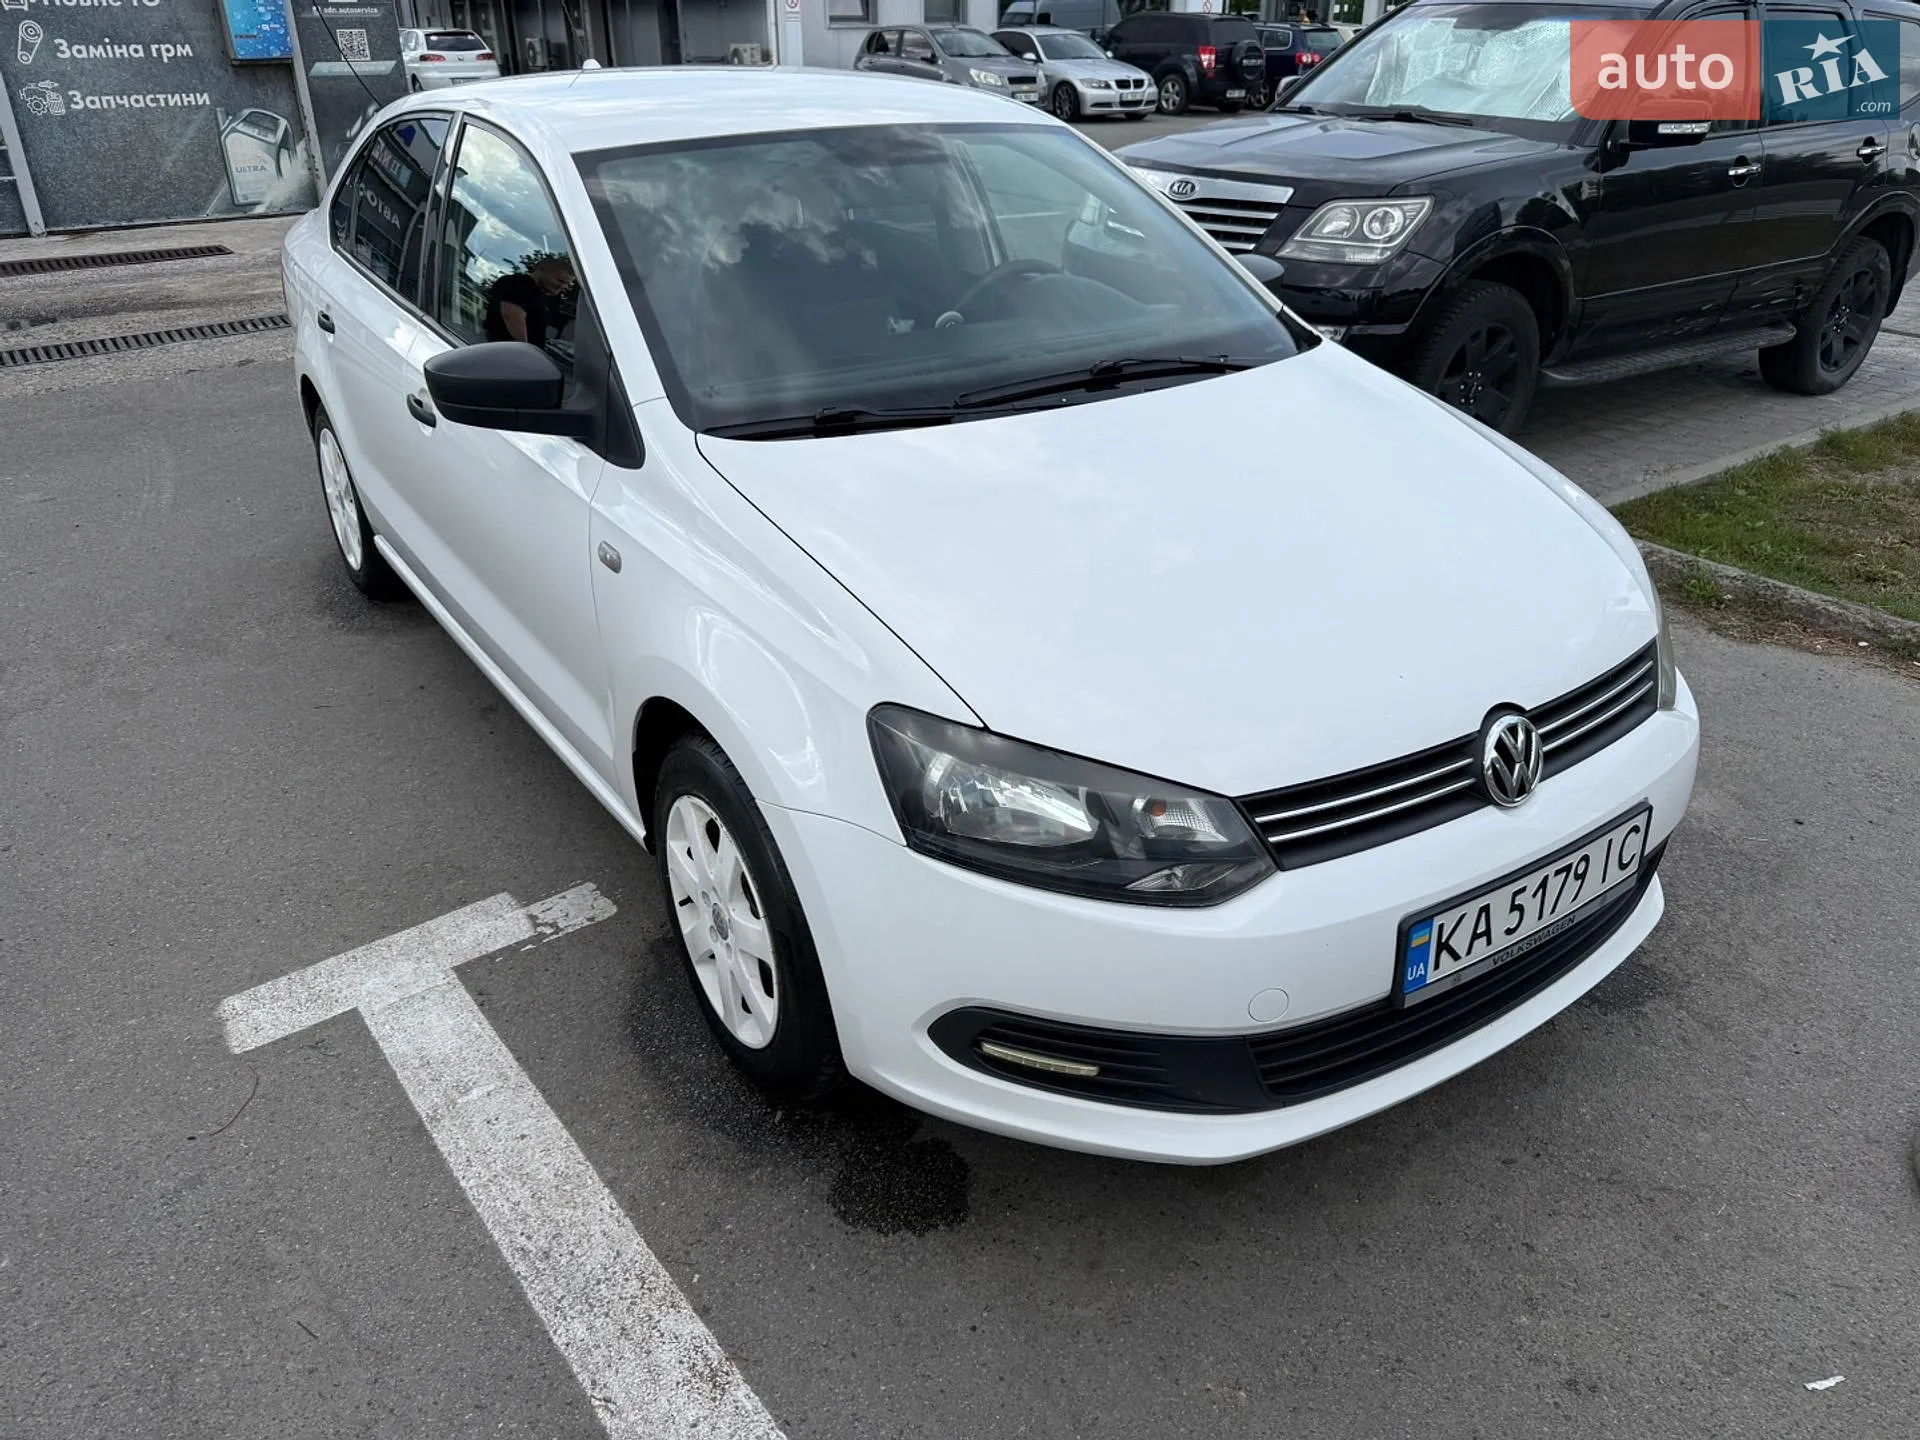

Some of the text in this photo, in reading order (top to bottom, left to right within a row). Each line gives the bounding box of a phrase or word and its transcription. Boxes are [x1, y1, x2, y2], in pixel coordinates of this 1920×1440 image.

[53, 37, 193, 63] Заміна грм
[67, 89, 211, 110] Запчастини
[235, 165, 268, 174] ULTRA
[1433, 824, 1641, 971] KA 5179 IC
[1492, 914, 1576, 966] VOLKSWAGEN
[1407, 963, 1425, 981] UA
